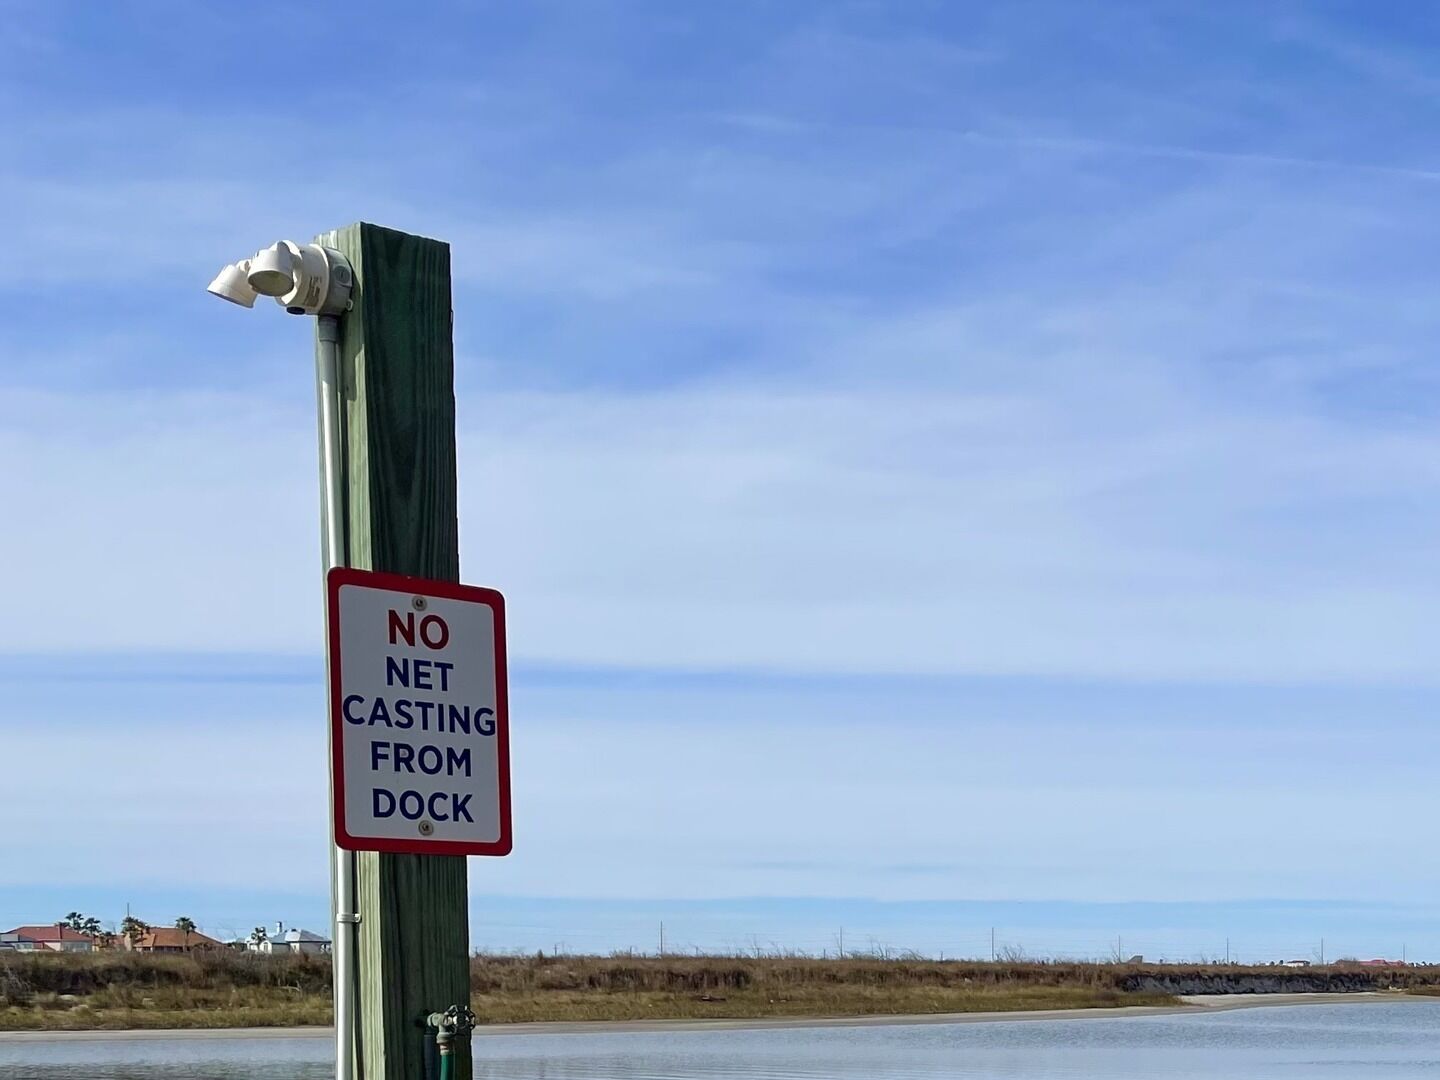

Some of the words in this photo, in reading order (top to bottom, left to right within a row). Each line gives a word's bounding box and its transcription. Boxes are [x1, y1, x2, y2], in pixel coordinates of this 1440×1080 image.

[388, 609, 449, 650] NO
[386, 656, 454, 692] NET
[342, 694, 496, 736] CASTING
[370, 741, 472, 777] FROM
[372, 788, 474, 823] DOCK
